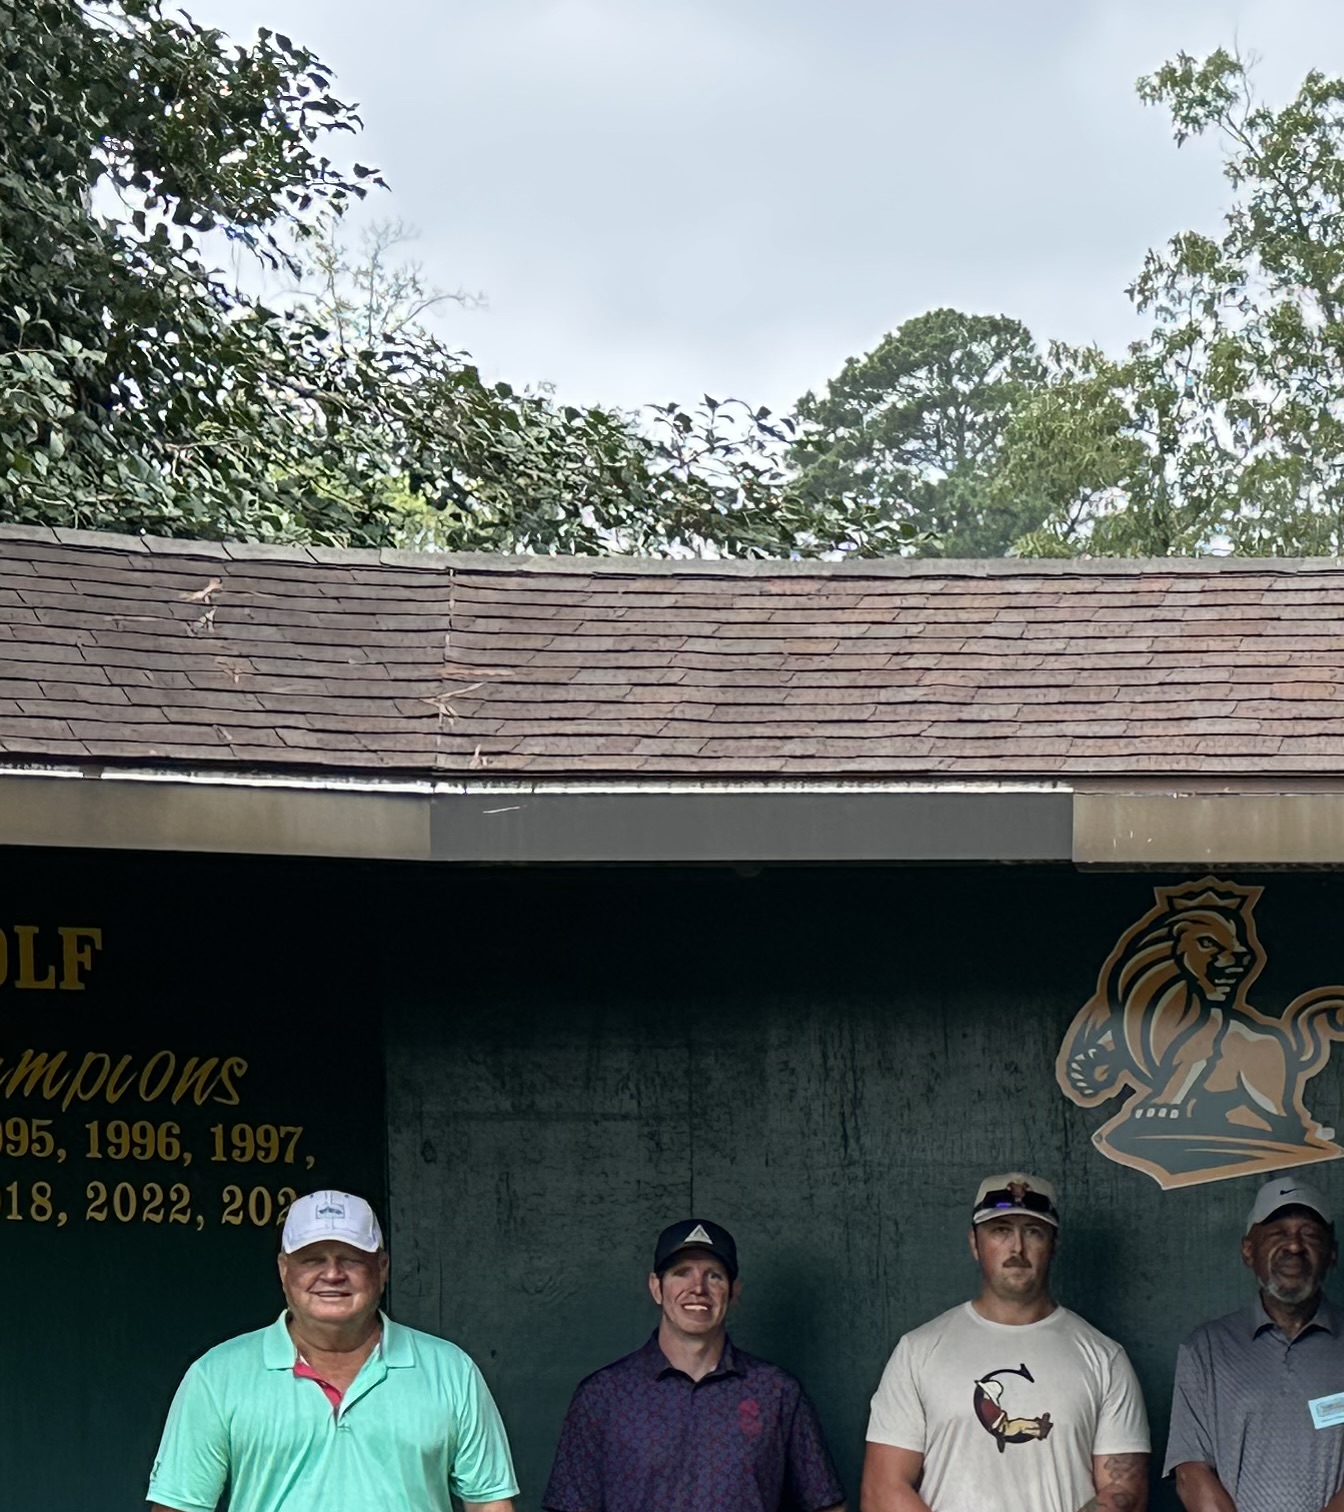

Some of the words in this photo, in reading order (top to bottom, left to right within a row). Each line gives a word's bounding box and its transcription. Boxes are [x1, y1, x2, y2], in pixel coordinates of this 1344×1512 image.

[0, 925, 103, 991] LF
[0, 1048, 248, 1112] mpions
[0, 1117, 67, 1163] 95,
[85, 1120, 192, 1166] 1996,
[210, 1122, 315, 1169] 1997,
[86, 1181, 205, 1231] 2022,
